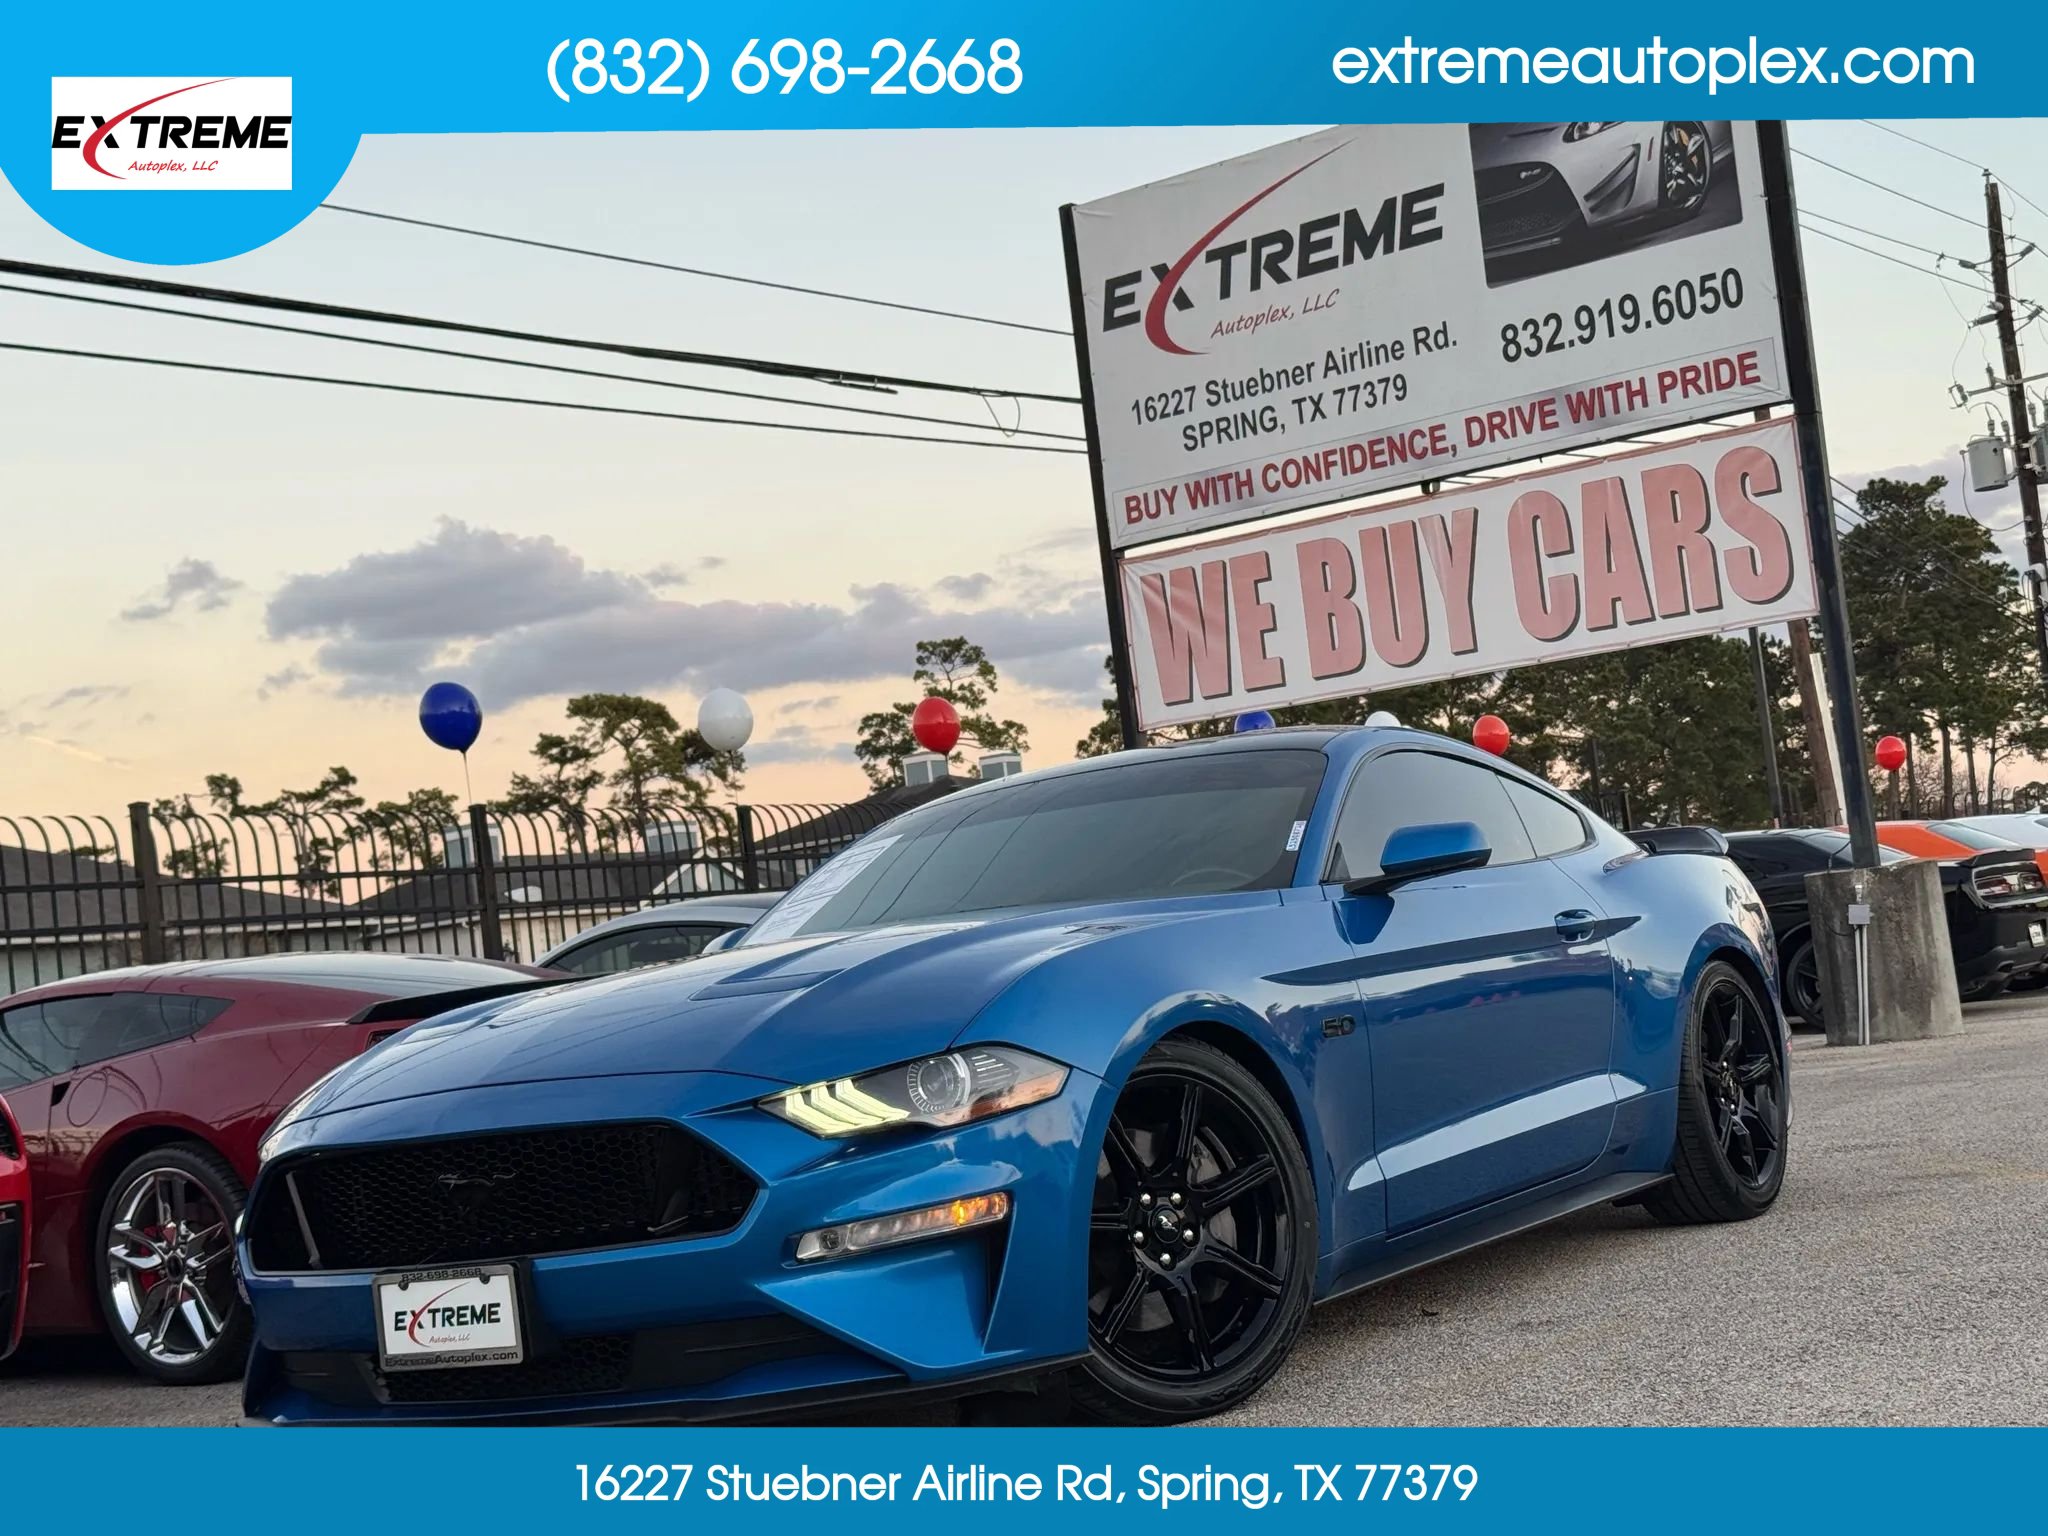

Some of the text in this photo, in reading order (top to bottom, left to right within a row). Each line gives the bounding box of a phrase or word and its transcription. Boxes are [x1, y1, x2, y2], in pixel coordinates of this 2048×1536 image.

[1102, 182, 1445, 333] EXTREME
[1210, 287, 1341, 340] Autoplex, LLC
[1500, 267, 1744, 363] 832.919.6050
[1131, 320, 1458, 426] 16227 Stuebner Airline Rd.
[1182, 373, 1409, 452] SPRING, TX 77379
[1124, 350, 1762, 525] BUY WITH CONFIDENCE, DRIVE WITH PRIDE
[1140, 445, 1795, 708] WE BUY CARS
[393, 1302, 502, 1332] EXTREME
[401, 1267, 482, 1283] 832-698-2668
[458, 1333, 471, 1342] LLC
